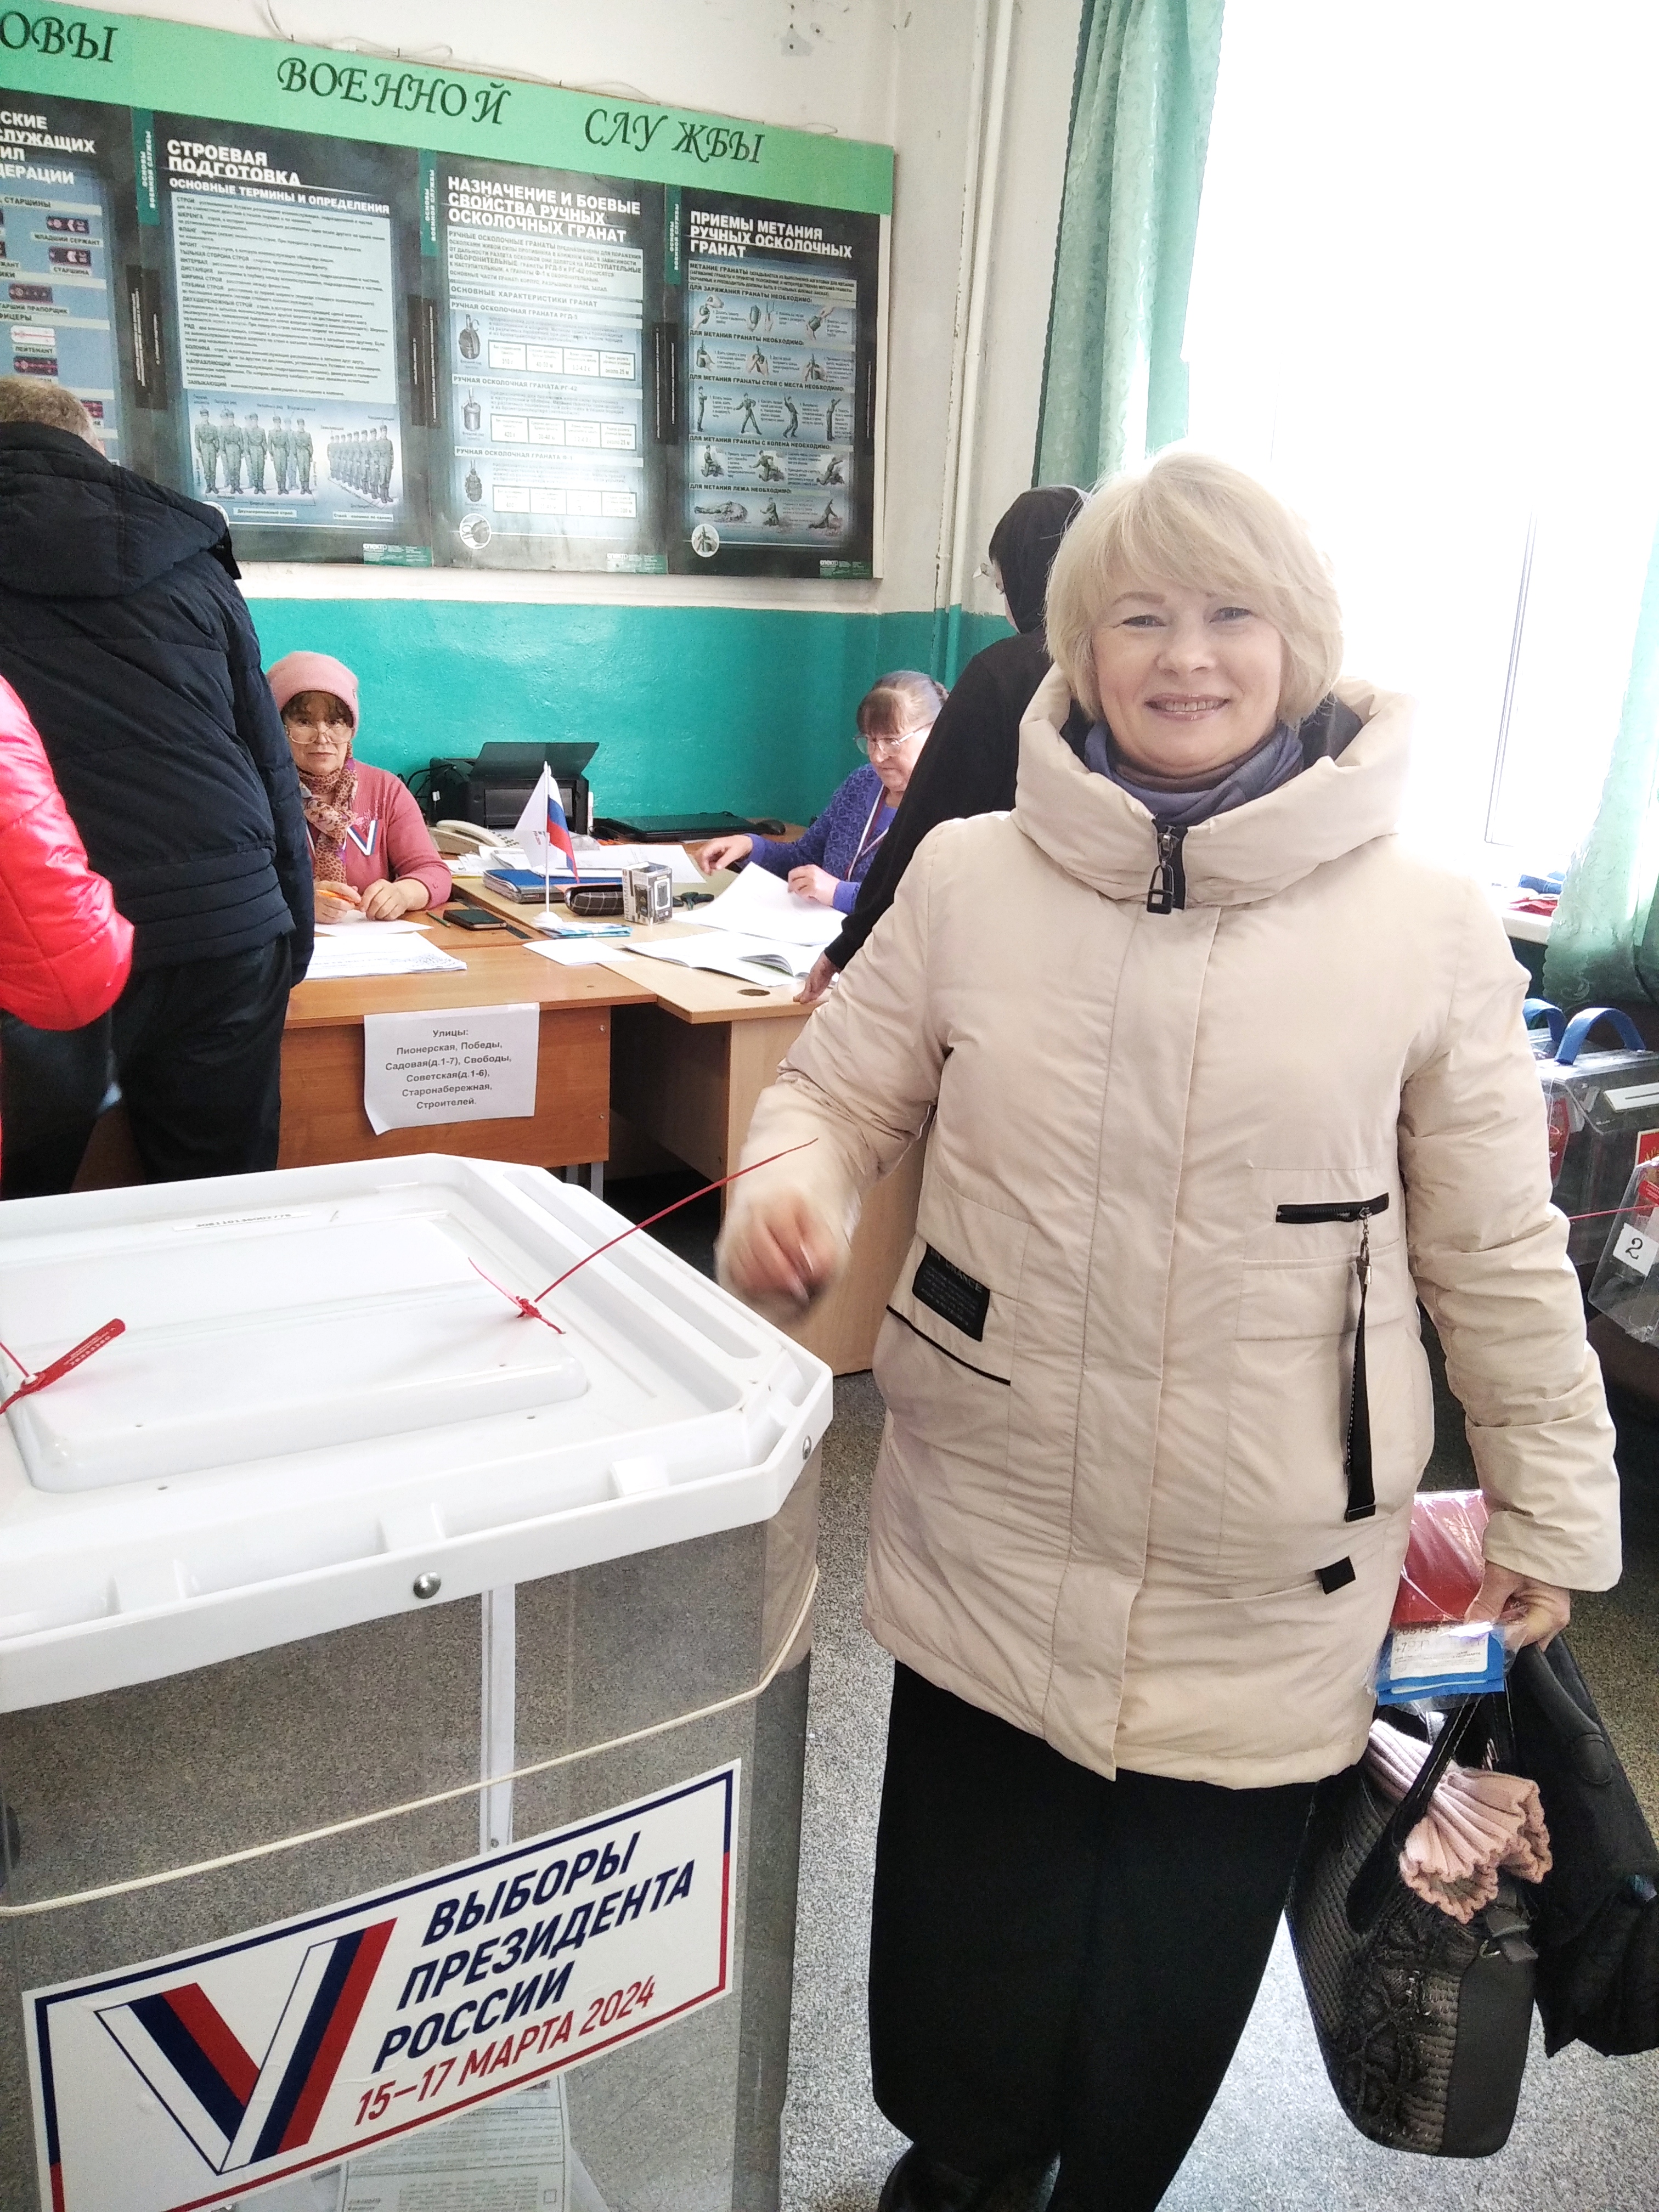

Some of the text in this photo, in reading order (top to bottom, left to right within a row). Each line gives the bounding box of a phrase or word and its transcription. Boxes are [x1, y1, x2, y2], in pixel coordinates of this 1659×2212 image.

[277, 57, 511, 125] ВОЕННОЙ
[1, 111, 48, 130] СКИЕ
[167, 139, 268, 168] СТРОЕВАЯ
[168, 156, 301, 187] ПОДГОТОВКА
[169, 176, 390, 215] ОСНОВНЫЕ ТЕРМИНЫ И ОПРЕДЕЛЕНИЯ
[448, 175, 641, 216] НАЗНАЧЕНИЕ И БОЕВЫЕ
[448, 192, 606, 225] СВОЙСТВА РУЧНЫХ
[448, 208, 628, 243] ОСКОЛОЧНЫХ ГРАНАТ
[691, 210, 823, 241] ПРИЕМЫ МЕТАНИЯ
[690, 225, 853, 259] РУЧНЫХ ОСКОЛОЧНЫХ
[690, 239, 747, 258] ГРАНАТ
[690, 263, 718, 272] МЕТАНИЕ
[451, 285, 597, 307] ОСНОВНЫЕ ХАРАКТЕРИСТИКИ ГРАНАТ
[703, 286, 741, 295] ЗАРЯЖАНИЯ
[742, 290, 770, 298] ГРАНАТЫ
[452, 301, 478, 309] РУЧНАЯ
[480, 304, 527, 315] ОСКОЛОЧНАЯ
[528, 309, 558, 318] ГРАНАТА
[703, 331, 732, 339] МЕТАНИЯ
[482, 378, 528, 387] ОСКОЛОЧНАЯ
[484, 450, 530, 458] ОСКОЛОЧНАЯ
[432, 1029, 469, 1038] Улицы:
[396, 1041, 503, 1056] Пионерская, Победы,
[464, 1054, 512, 1064] Свободы,
[402, 1082, 493, 1097] Старонабережная,
[416, 1097, 477, 1109] Строителей.
[1625, 1238, 1643, 1260] 2
[421, 1831, 642, 1948] ВЫБОРЫ
[396, 1858, 696, 2010] ПРЕЗИДЕНТА
[370, 1960, 575, 2074] РОССИИ
[456, 2012, 574, 2089] МАРТА
[580, 1973, 655, 2038] 2024
